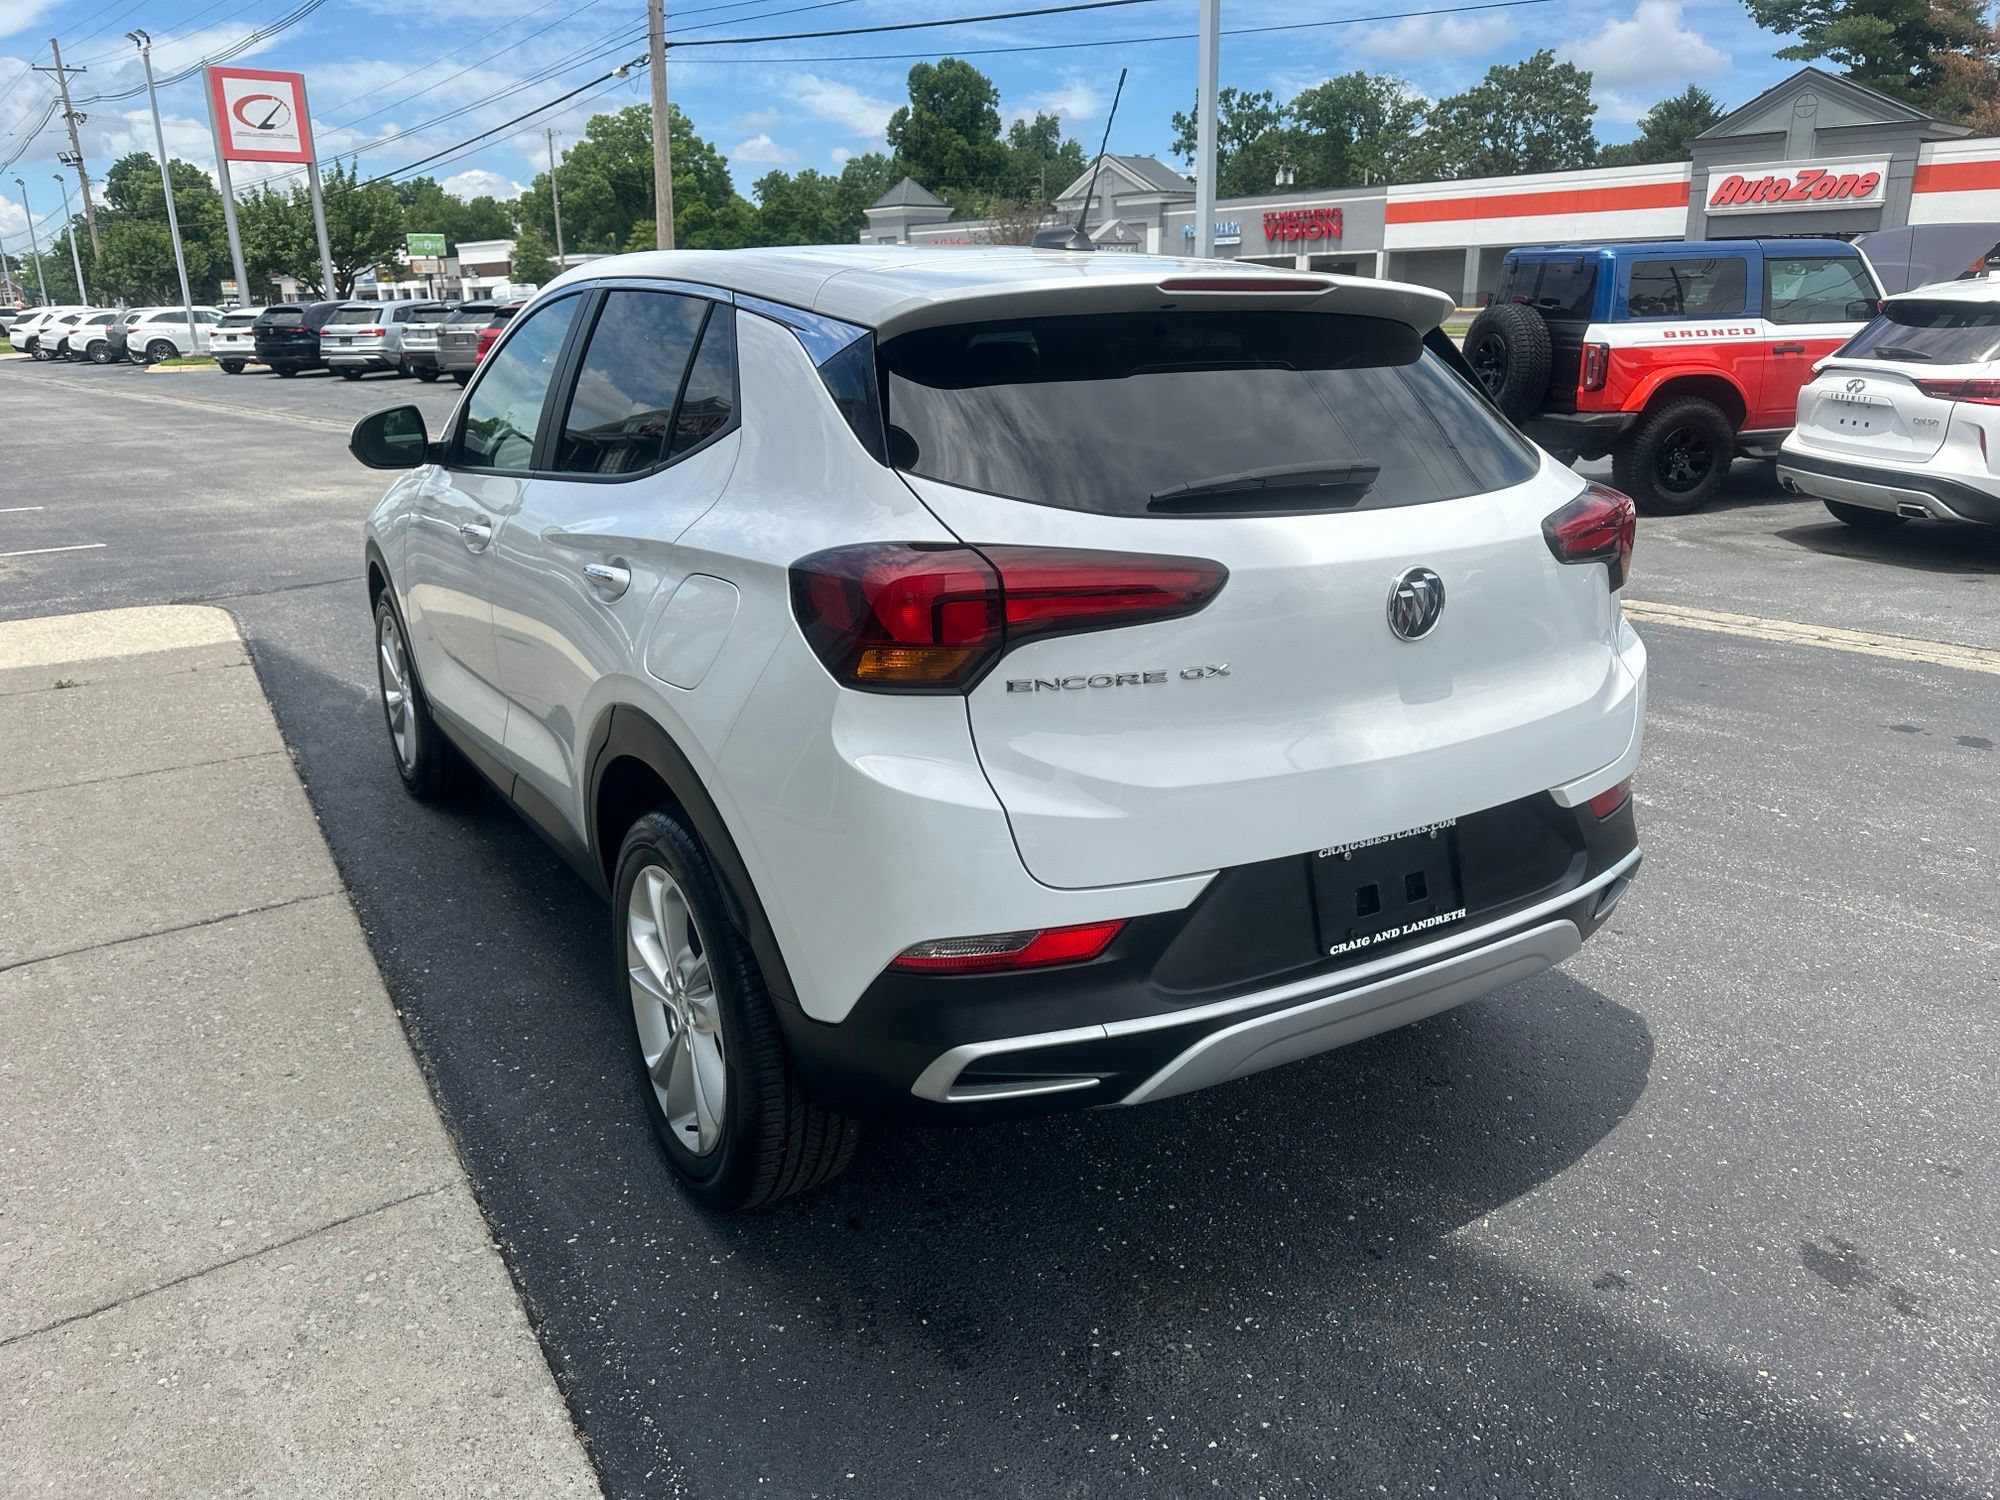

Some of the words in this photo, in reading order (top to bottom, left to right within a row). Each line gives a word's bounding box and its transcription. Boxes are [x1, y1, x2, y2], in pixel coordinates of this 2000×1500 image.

[1709, 169, 1880, 205] AutoZone
[1263, 217, 1343, 241] VISION
[1663, 327, 1756, 338] BRONCO
[1830, 393, 1872, 403] INFINITI
[1006, 669, 1169, 693] ENCORE
[1179, 663, 1231, 681] GX
[1318, 817, 1457, 858] CRAIGSBESTCARS.COM
[1329, 937, 1371, 955] CRAIG
[1373, 928, 1401, 943] AND
[1402, 908, 1467, 935] LANDRETH
